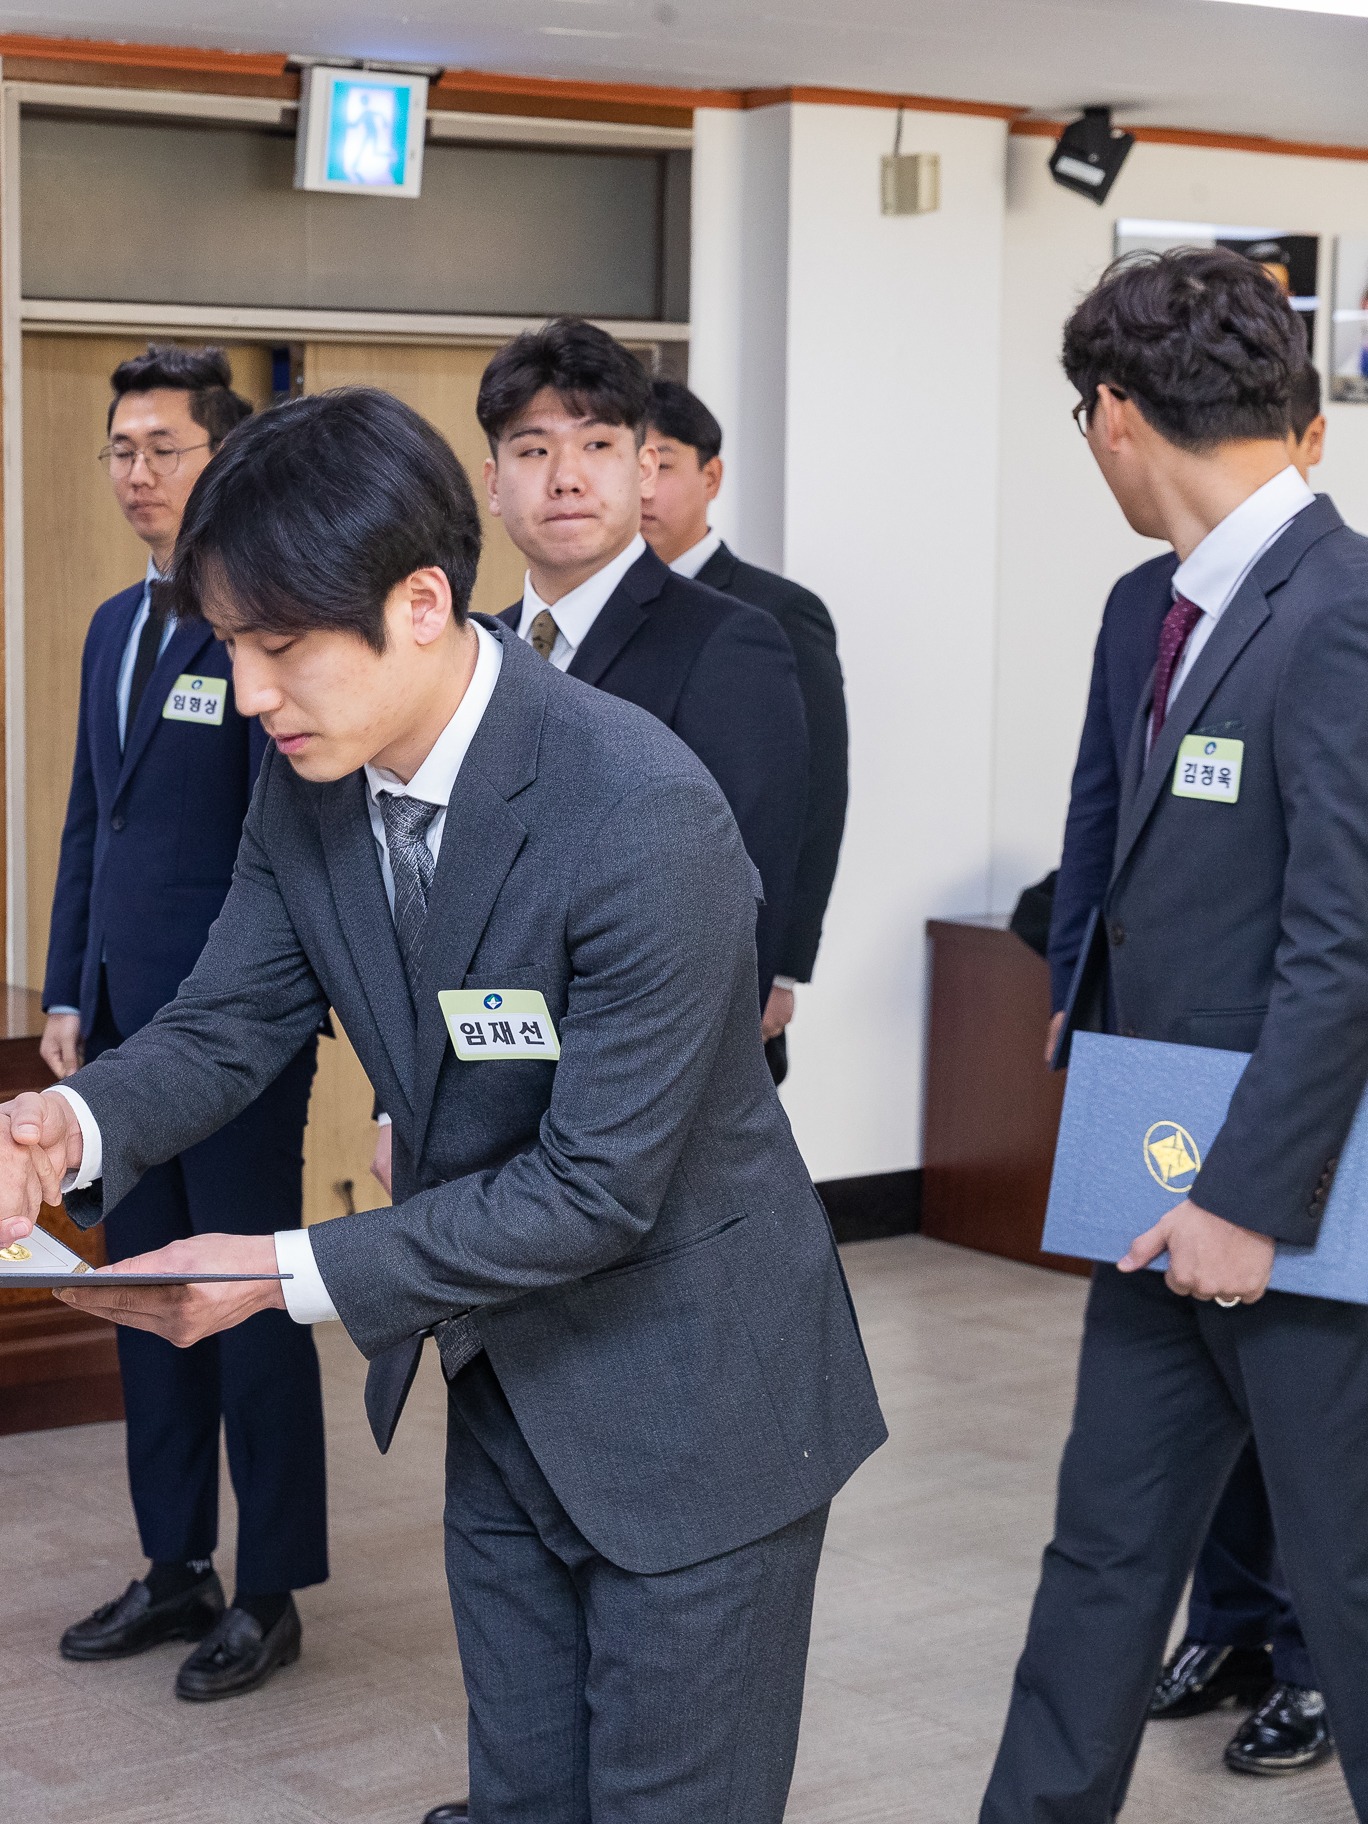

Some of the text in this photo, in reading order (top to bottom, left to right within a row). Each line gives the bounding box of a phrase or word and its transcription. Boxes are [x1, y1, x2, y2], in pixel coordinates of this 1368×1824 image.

[173, 694, 218, 715] 임형상
[1184, 763, 1232, 789] 김정욱
[459, 1021, 546, 1046] 임재선
